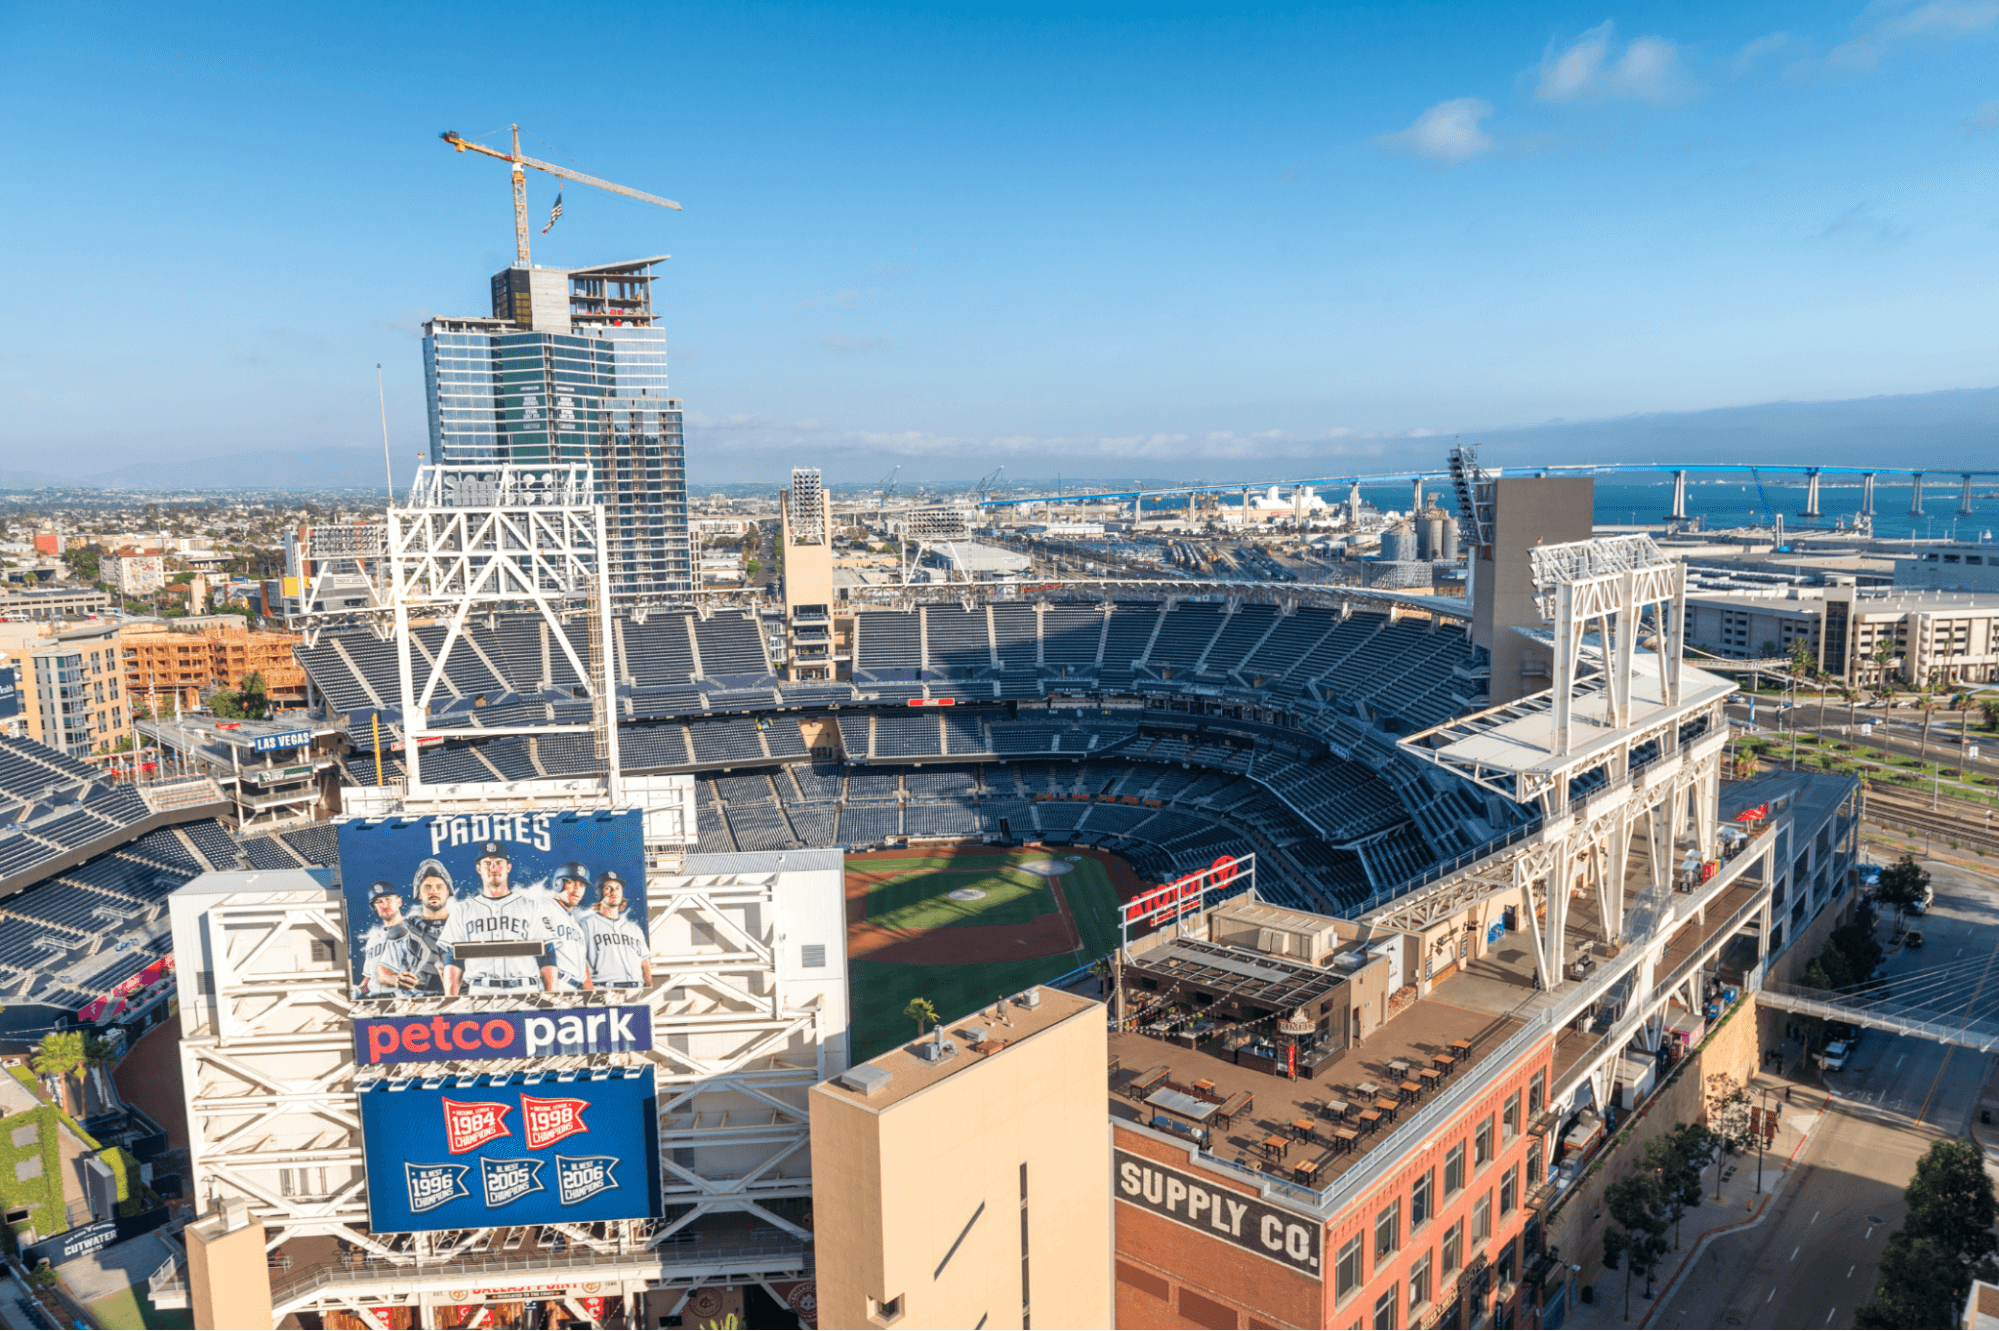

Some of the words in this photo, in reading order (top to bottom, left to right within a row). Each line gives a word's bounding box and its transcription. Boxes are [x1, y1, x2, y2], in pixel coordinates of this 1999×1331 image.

[257, 737, 276, 750] LAS
[278, 732, 310, 747] VEGAS
[430, 814, 551, 855] PADRES
[466, 915, 530, 942] PADRES
[593, 933, 641, 958] PADRES
[368, 1016, 515, 1063] petco
[525, 1008, 636, 1056] park
[452, 1112, 496, 1136] 1984
[530, 1108, 573, 1132] 1998
[455, 1126, 496, 1148] CHAMPIONS
[532, 1122, 573, 1144] CHAMPIONS
[411, 1174, 453, 1197] 1996
[488, 1168, 529, 1191] 2005
[563, 1166, 604, 1189] 2006
[414, 1188, 454, 1209] CHAMPIONS
[489, 1182, 529, 1203] CHAMPIONS
[564, 1180, 604, 1201] CHAMPIONS
[1120, 1161, 1248, 1237] SUPPLY
[1260, 1214, 1319, 1268] CO.
[64, 1229, 117, 1256] CUTWATER
